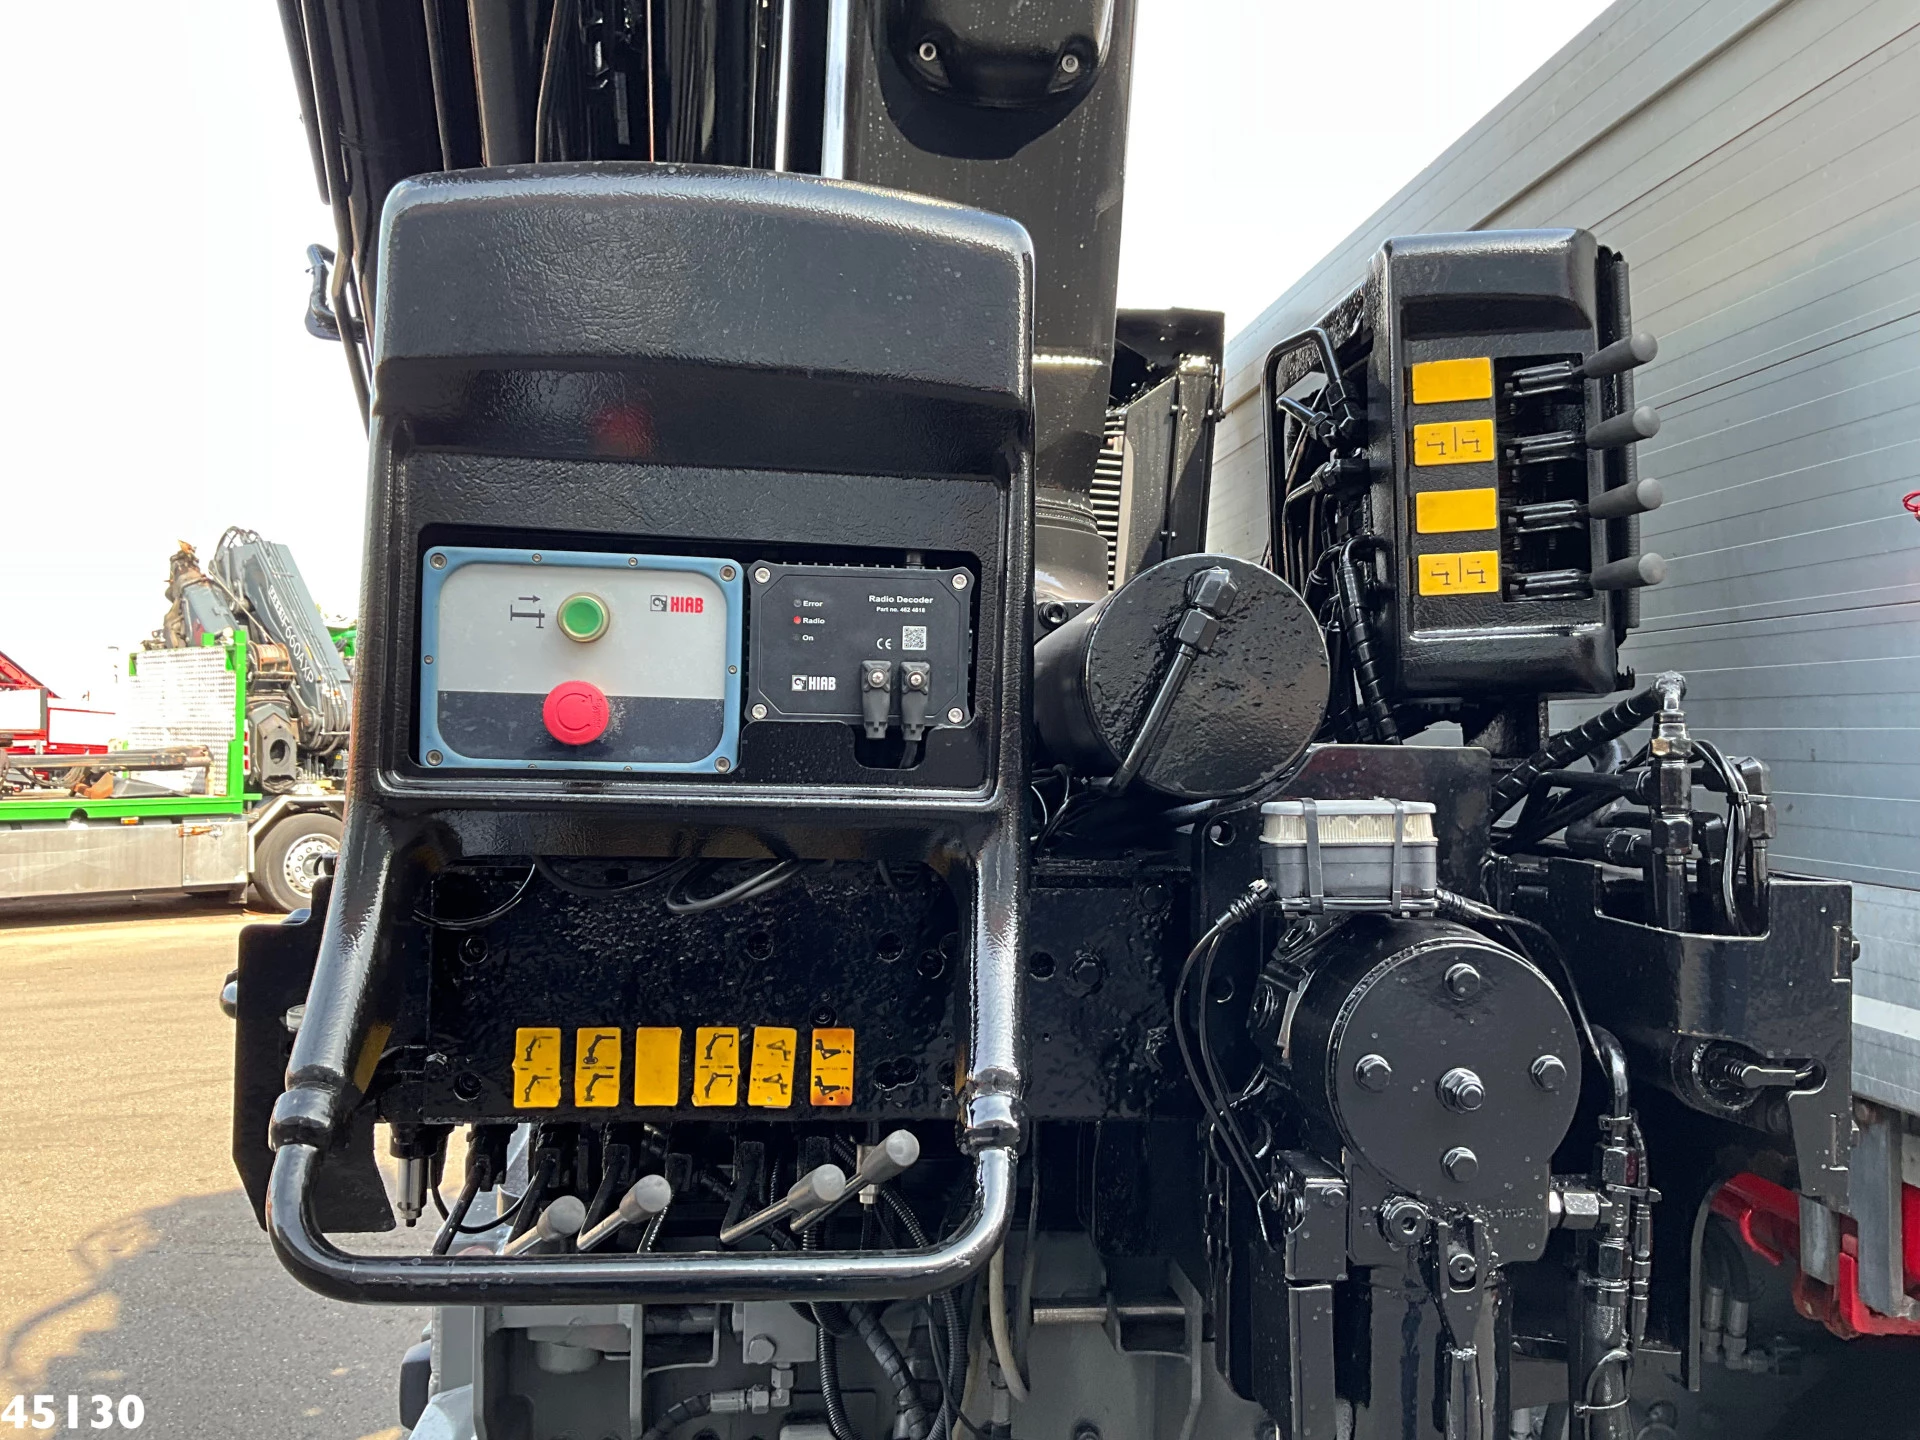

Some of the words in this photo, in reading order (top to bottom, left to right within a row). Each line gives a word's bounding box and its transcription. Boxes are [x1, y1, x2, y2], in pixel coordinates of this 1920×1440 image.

[868, 594, 895, 603] Radio
[896, 595, 934, 604] Decoder
[670, 596, 704, 614] HIAB
[802, 617, 826, 625] Radio
[802, 634, 814, 642] On
[876, 637, 892, 650] CE
[808, 676, 837, 691] HIAB
